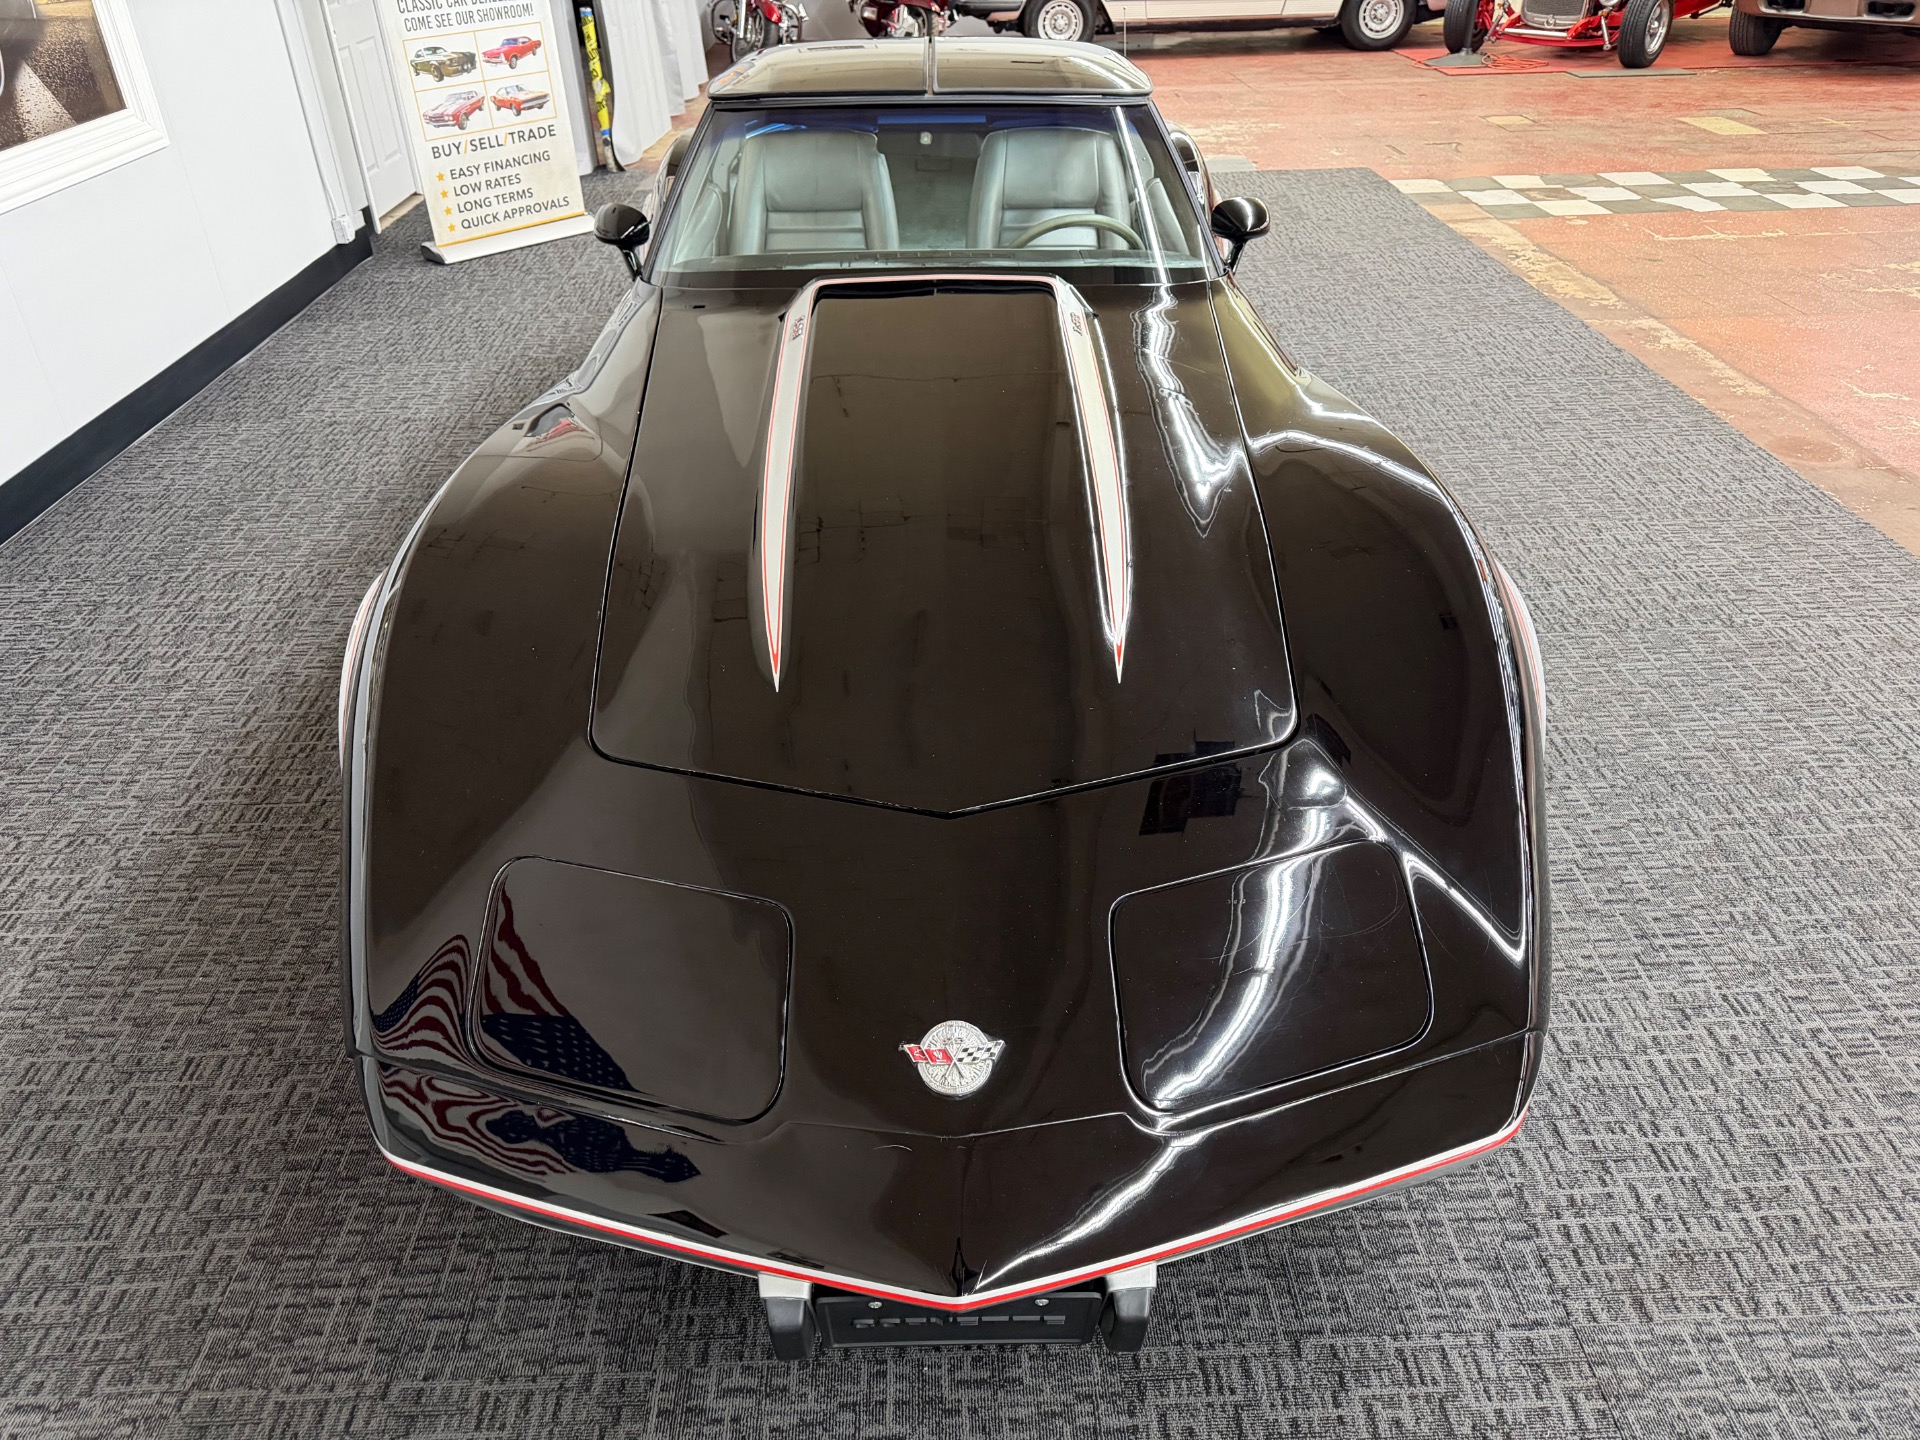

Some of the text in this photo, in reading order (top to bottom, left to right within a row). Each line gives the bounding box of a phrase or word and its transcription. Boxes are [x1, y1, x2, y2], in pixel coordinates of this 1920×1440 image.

[404, 2, 534, 32] COME SEE OUR SHOWROOM!
[449, 150, 551, 180] EASY FINANCING
[453, 173, 522, 197] LOW RATES
[457, 187, 534, 214] LONG TERMS
[461, 196, 570, 230] QUICK APPROVALS
